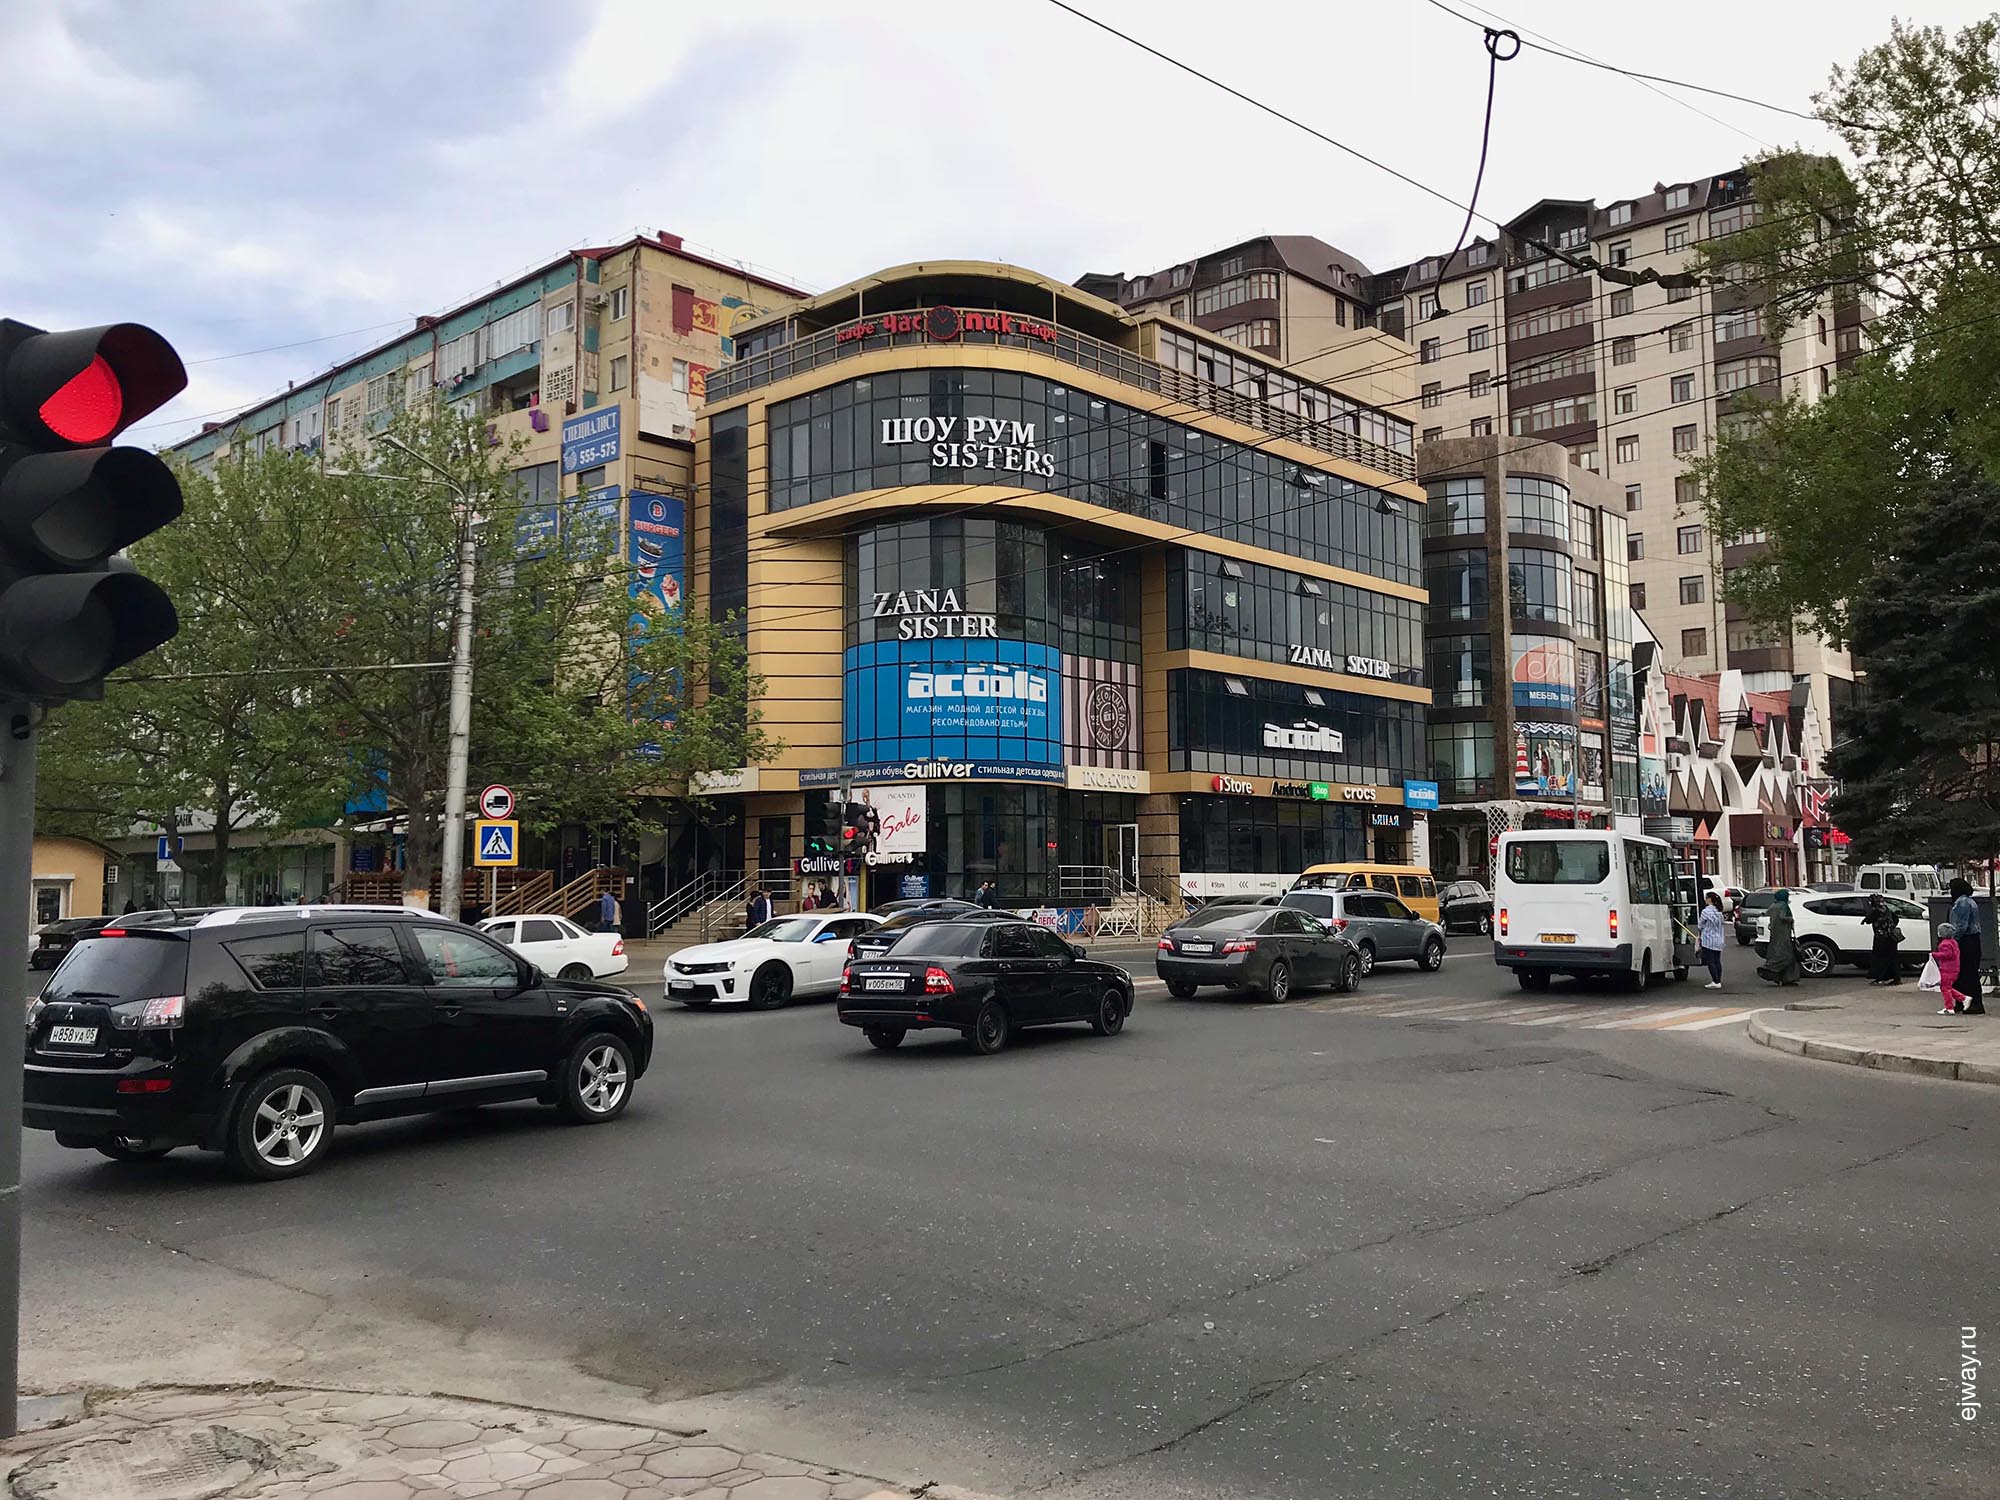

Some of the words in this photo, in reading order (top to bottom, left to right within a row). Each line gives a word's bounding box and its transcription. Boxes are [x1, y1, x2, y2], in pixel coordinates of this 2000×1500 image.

[562, 412, 617, 444] СПЕЦИАЛИСТ
[881, 416, 958, 445] ШОУ
[966, 416, 1036, 449] РУМ
[579, 441, 617, 465] 555-575
[932, 442, 1055, 478] SISTERS
[633, 519, 680, 538] BURGERS
[873, 588, 963, 618] ZANA
[898, 615, 999, 641] SISTER
[1290, 643, 1334, 669] ZANA
[1347, 655, 1392, 680] SISTER
[1529, 691, 1559, 701] МЕБЕЛЬ
[905, 704, 943, 714] МАГАЗИН
[947, 704, 981, 713] МОДНОЙ
[985, 705, 1017, 715] ДЕТСКОЙ
[931, 717, 1000, 728] РЕКОМЕНДОВАНО
[854, 767, 875, 778] дежда
[904, 761, 975, 779] Gulliver
[977, 765, 1015, 775] стильная
[1016, 767, 1042, 777] детская
[1083, 771, 1138, 789] INCANTO
[887, 792, 916, 800] INCANTO
[1313, 785, 1328, 796] shop
[1343, 785, 1377, 801] crocs
[882, 806, 921, 841] Sale
[800, 855, 841, 873] Gullive
[865, 850, 906, 867] Gulliver
